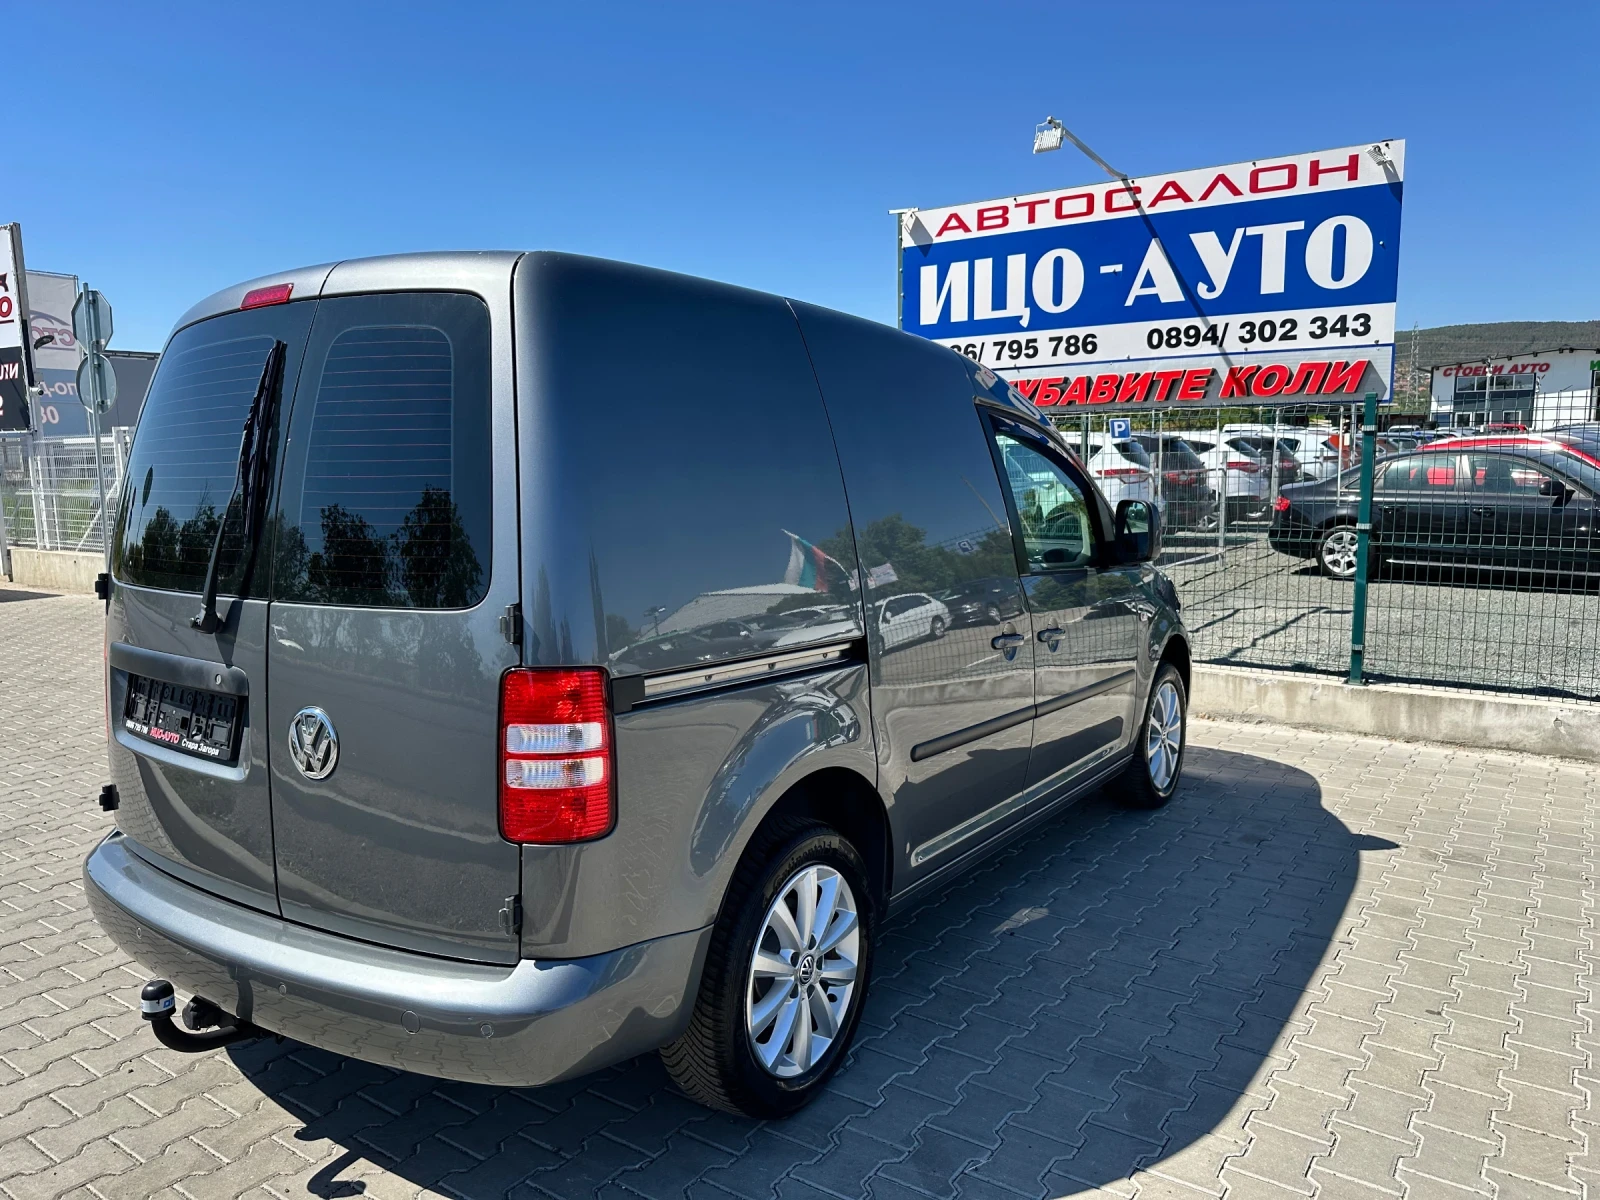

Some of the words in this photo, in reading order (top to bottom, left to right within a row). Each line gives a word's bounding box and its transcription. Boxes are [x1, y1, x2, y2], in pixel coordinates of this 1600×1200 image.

[934, 153, 1361, 239] АВТОСАЛОН
[992, 338, 1039, 361] 795
[1048, 333, 1098, 357] 786
[1146, 321, 1228, 351] 0894/
[1238, 316, 1298, 345] 302
[1310, 312, 1372, 340] 343
[1009, 366, 1214, 407] УБАВИТЕ
[1218, 358, 1371, 398] КОЛИ
[1508, 362, 1550, 374] АУТО
[1113, 421, 1126, 437] P
